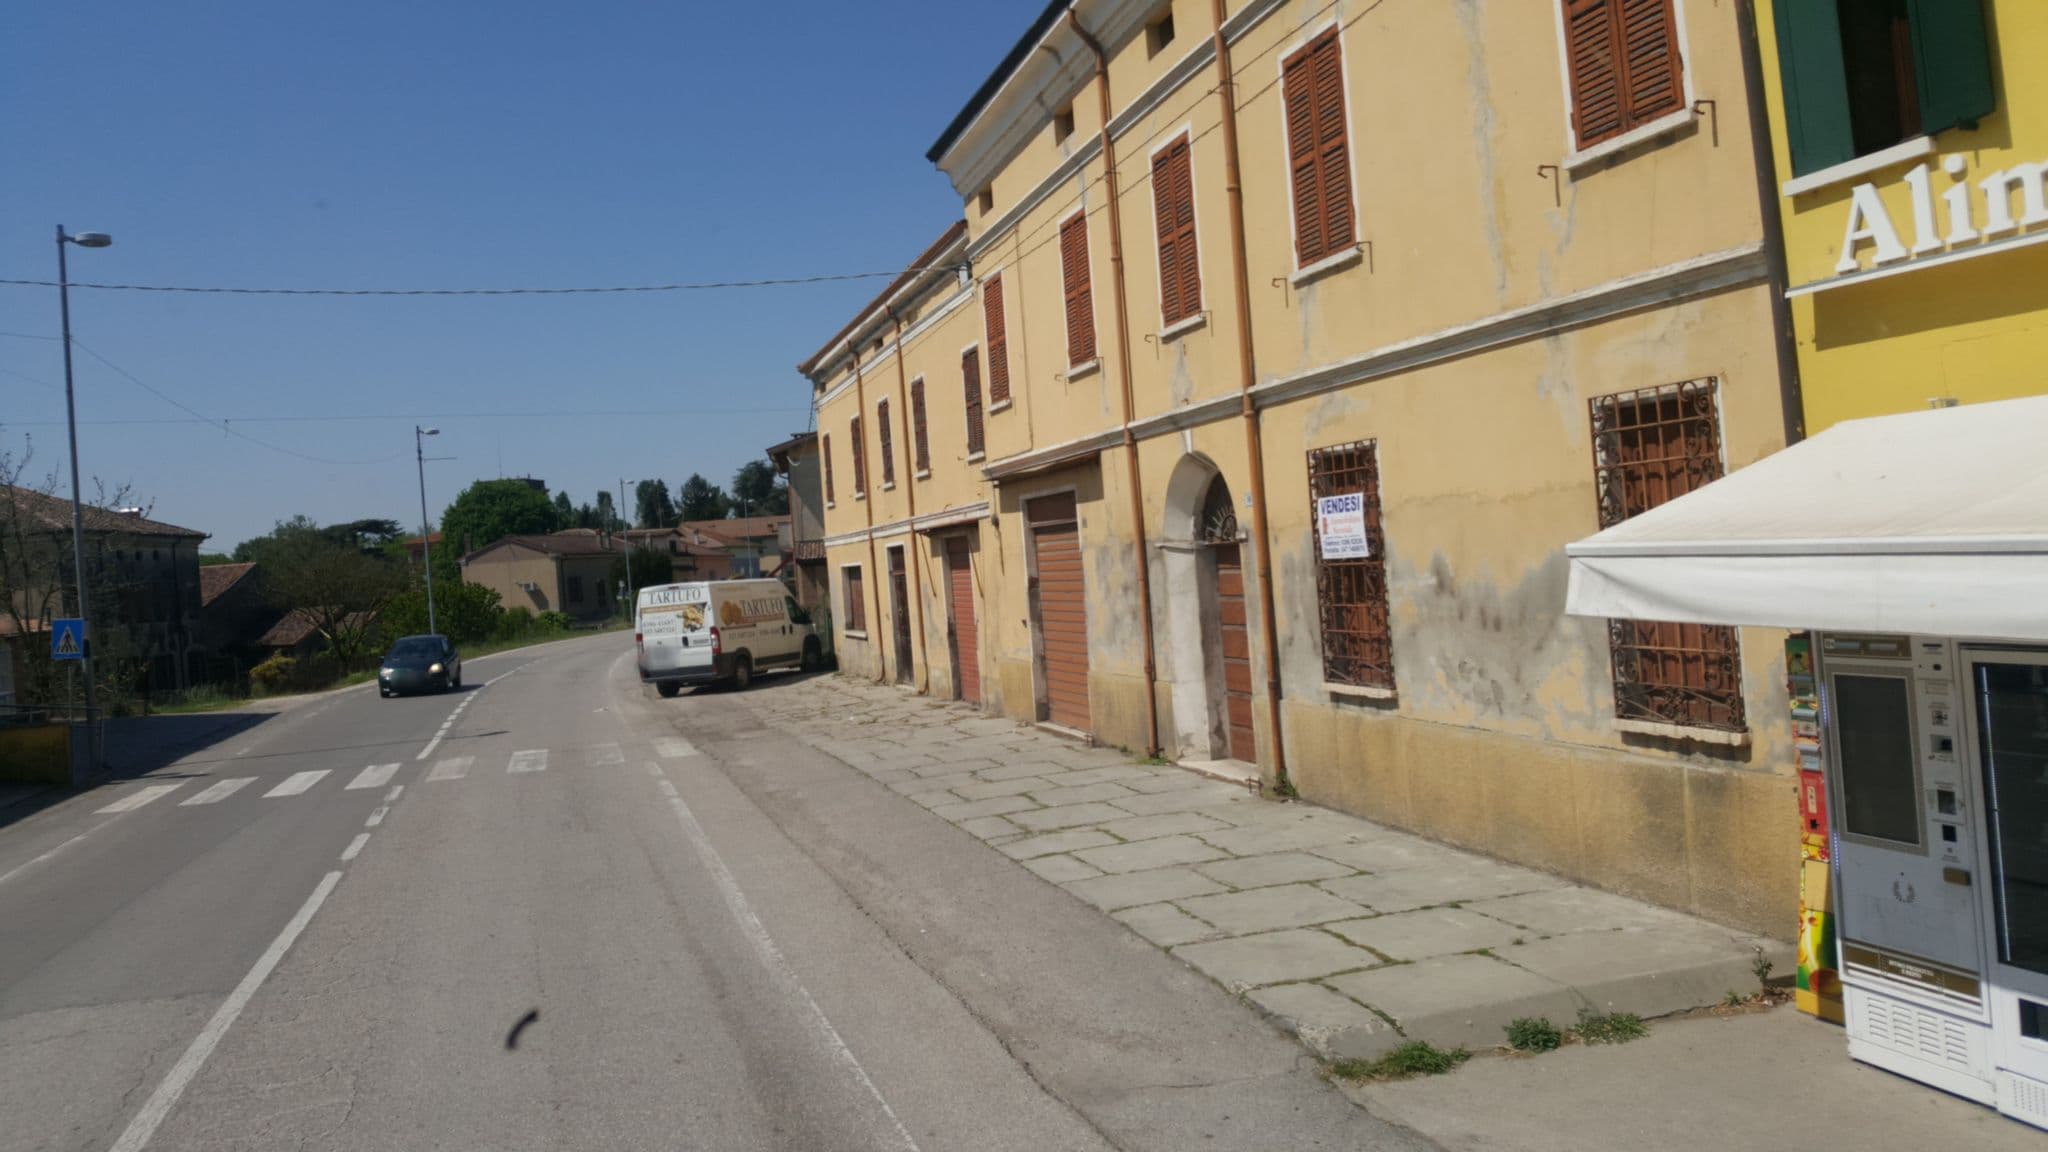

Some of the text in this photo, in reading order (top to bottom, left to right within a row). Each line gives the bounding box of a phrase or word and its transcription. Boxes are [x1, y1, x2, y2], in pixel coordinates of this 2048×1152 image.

[1320, 495, 1360, 515] VENDESI
[648, 588, 701, 604] TARTUFO
[740, 599, 783, 617] TARTUFO
